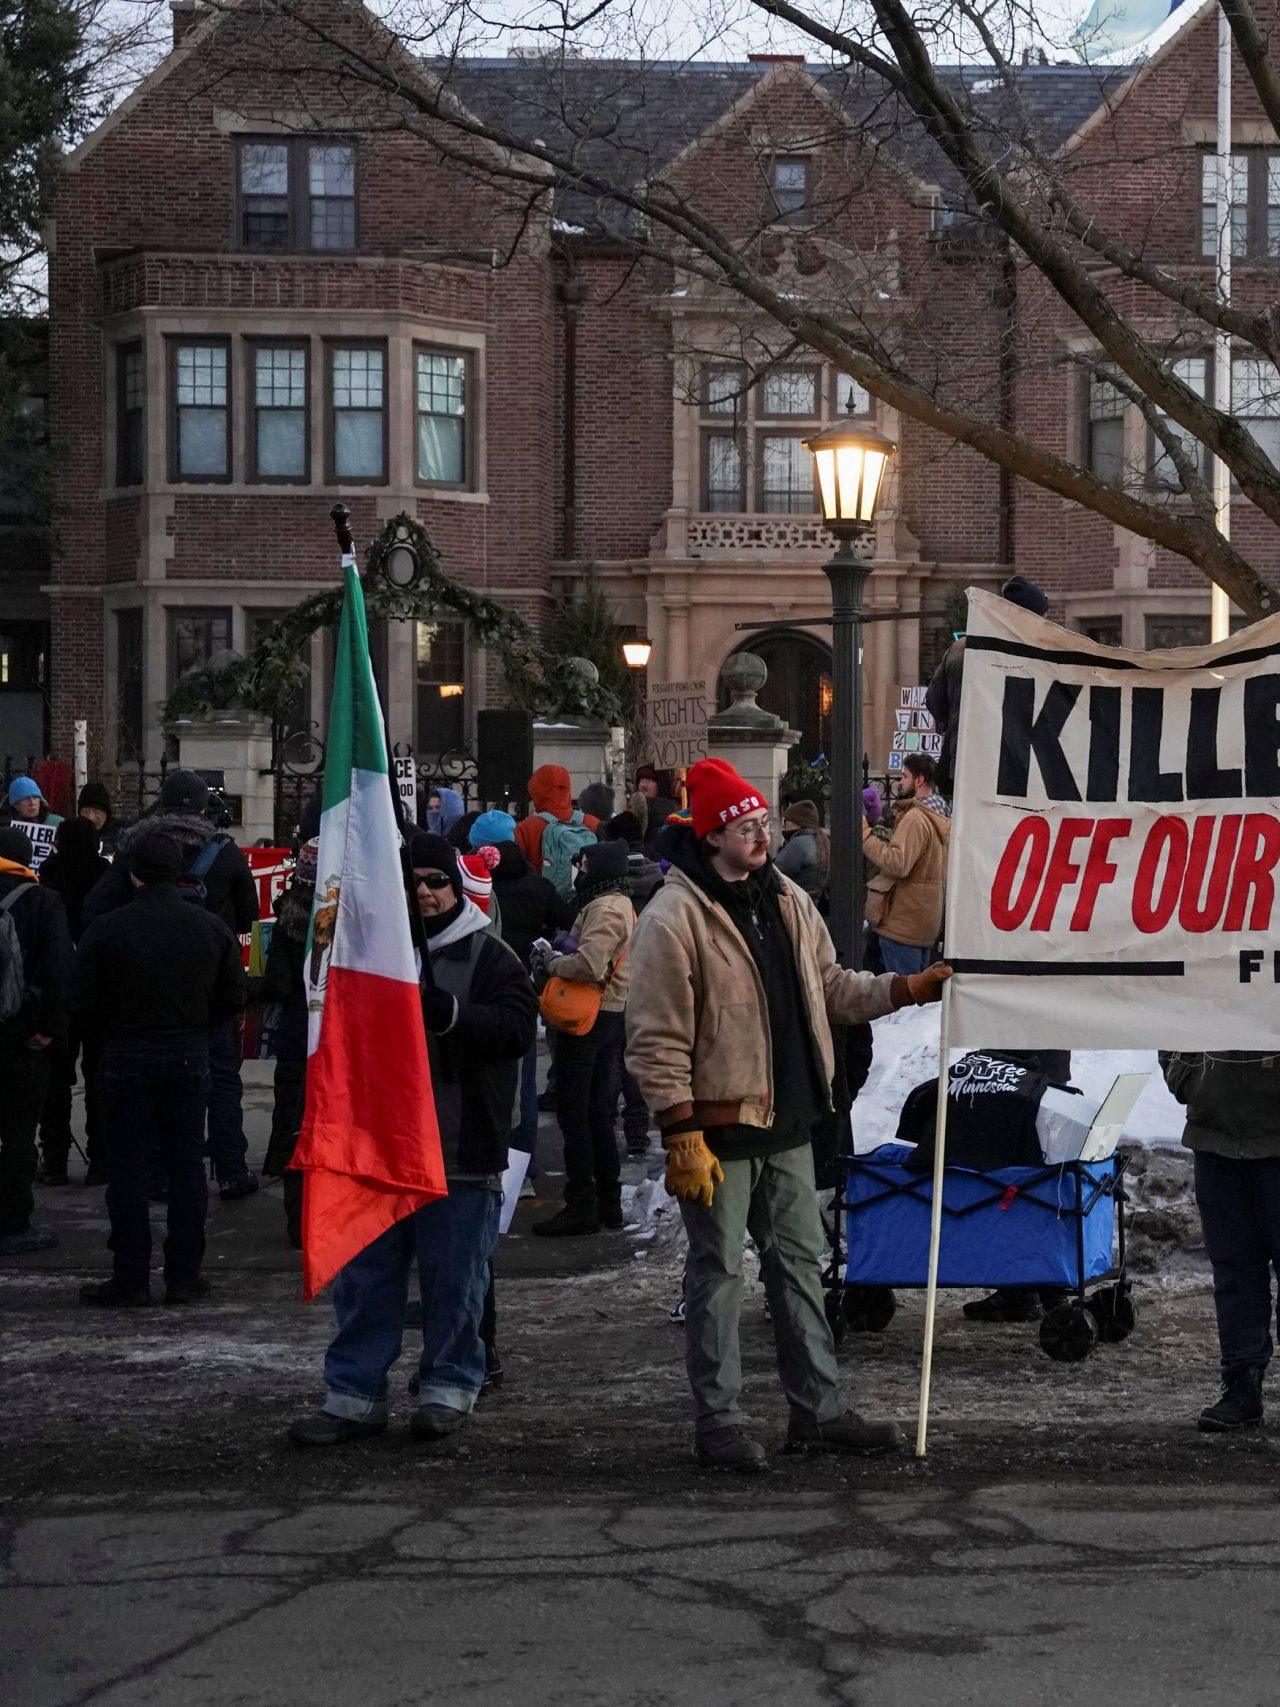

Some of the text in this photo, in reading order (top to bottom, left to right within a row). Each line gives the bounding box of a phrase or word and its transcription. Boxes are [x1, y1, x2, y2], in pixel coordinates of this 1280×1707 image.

[653, 696, 708, 727] RIGHTS
[654, 738, 708, 768] VOTES
[719, 796, 760, 822] FRSO
[990, 815, 1131, 933] OFF
[947, 1080, 1019, 1102] Minnesota
